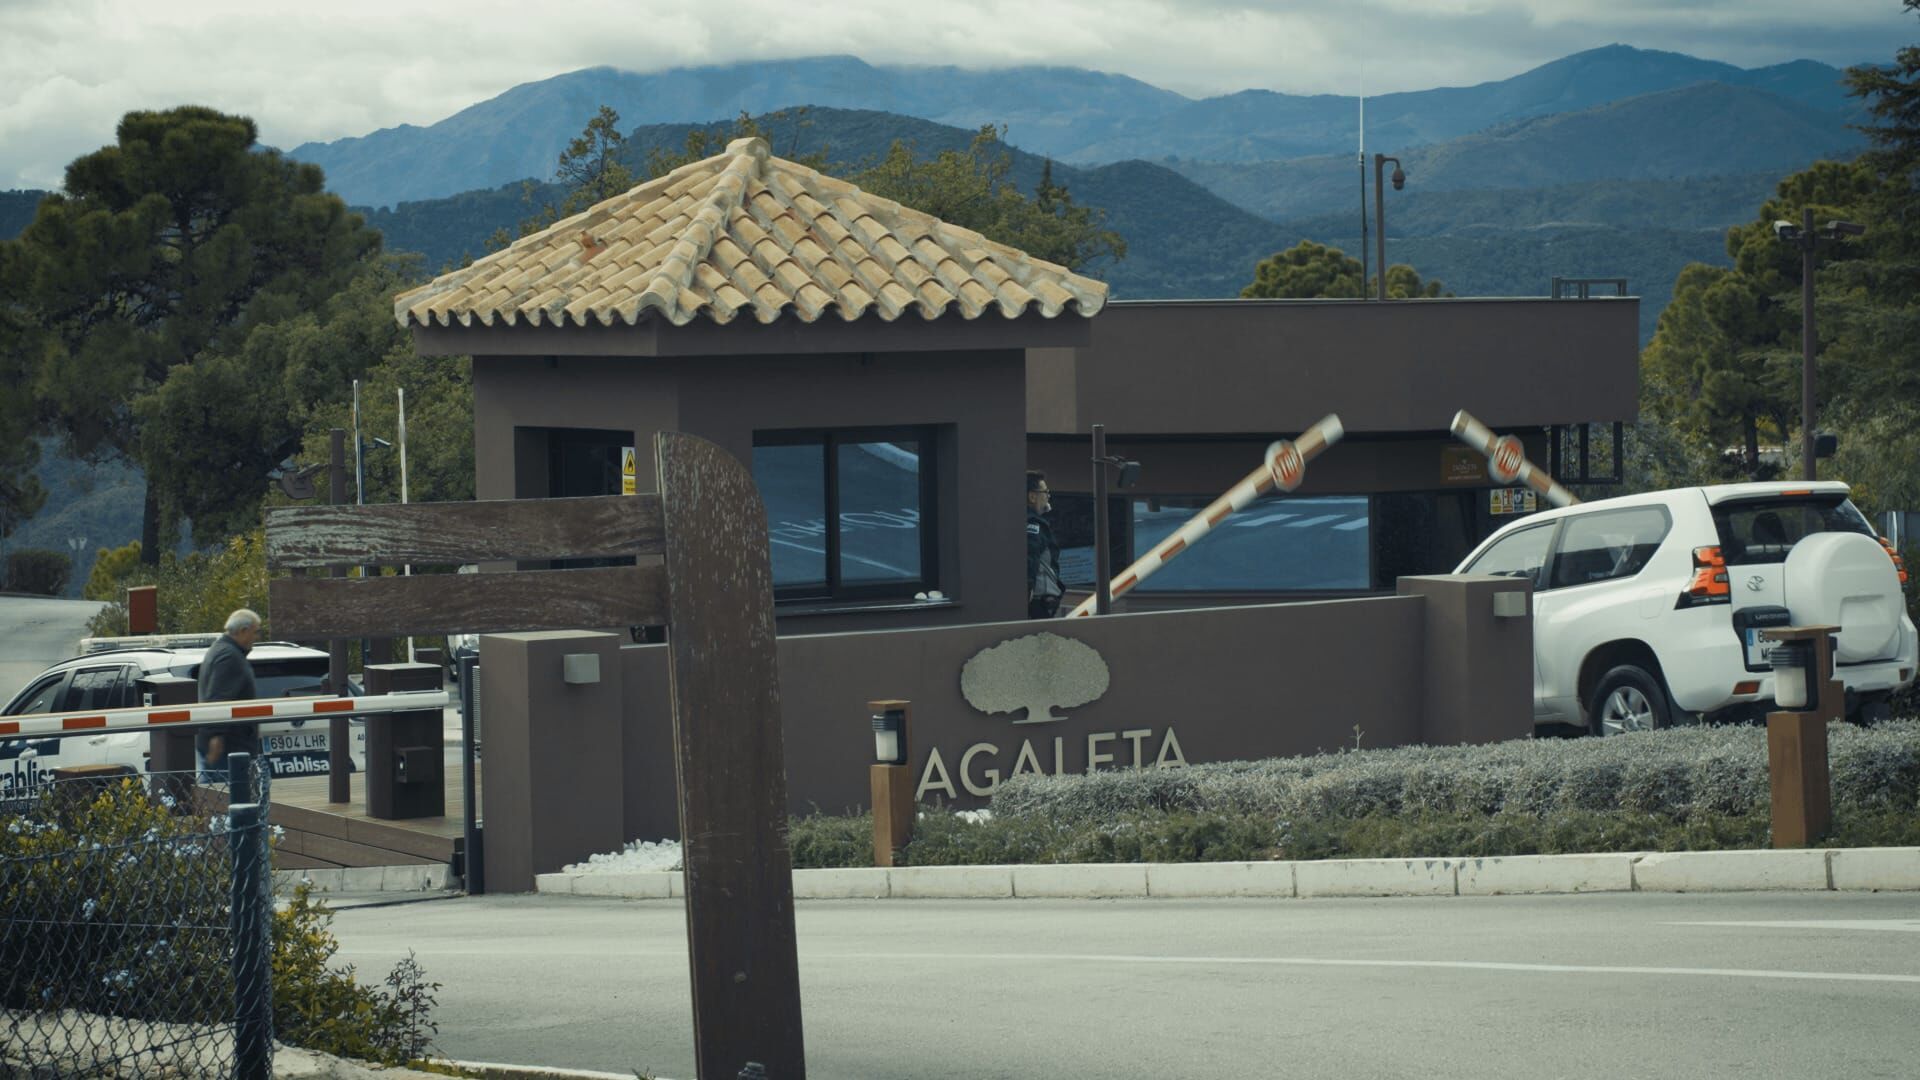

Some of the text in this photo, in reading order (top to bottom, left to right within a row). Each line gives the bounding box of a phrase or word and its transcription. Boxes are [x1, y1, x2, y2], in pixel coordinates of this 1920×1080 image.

[271, 734, 327, 750] 6904 LHR
[269, 755, 330, 774] Trablisa
